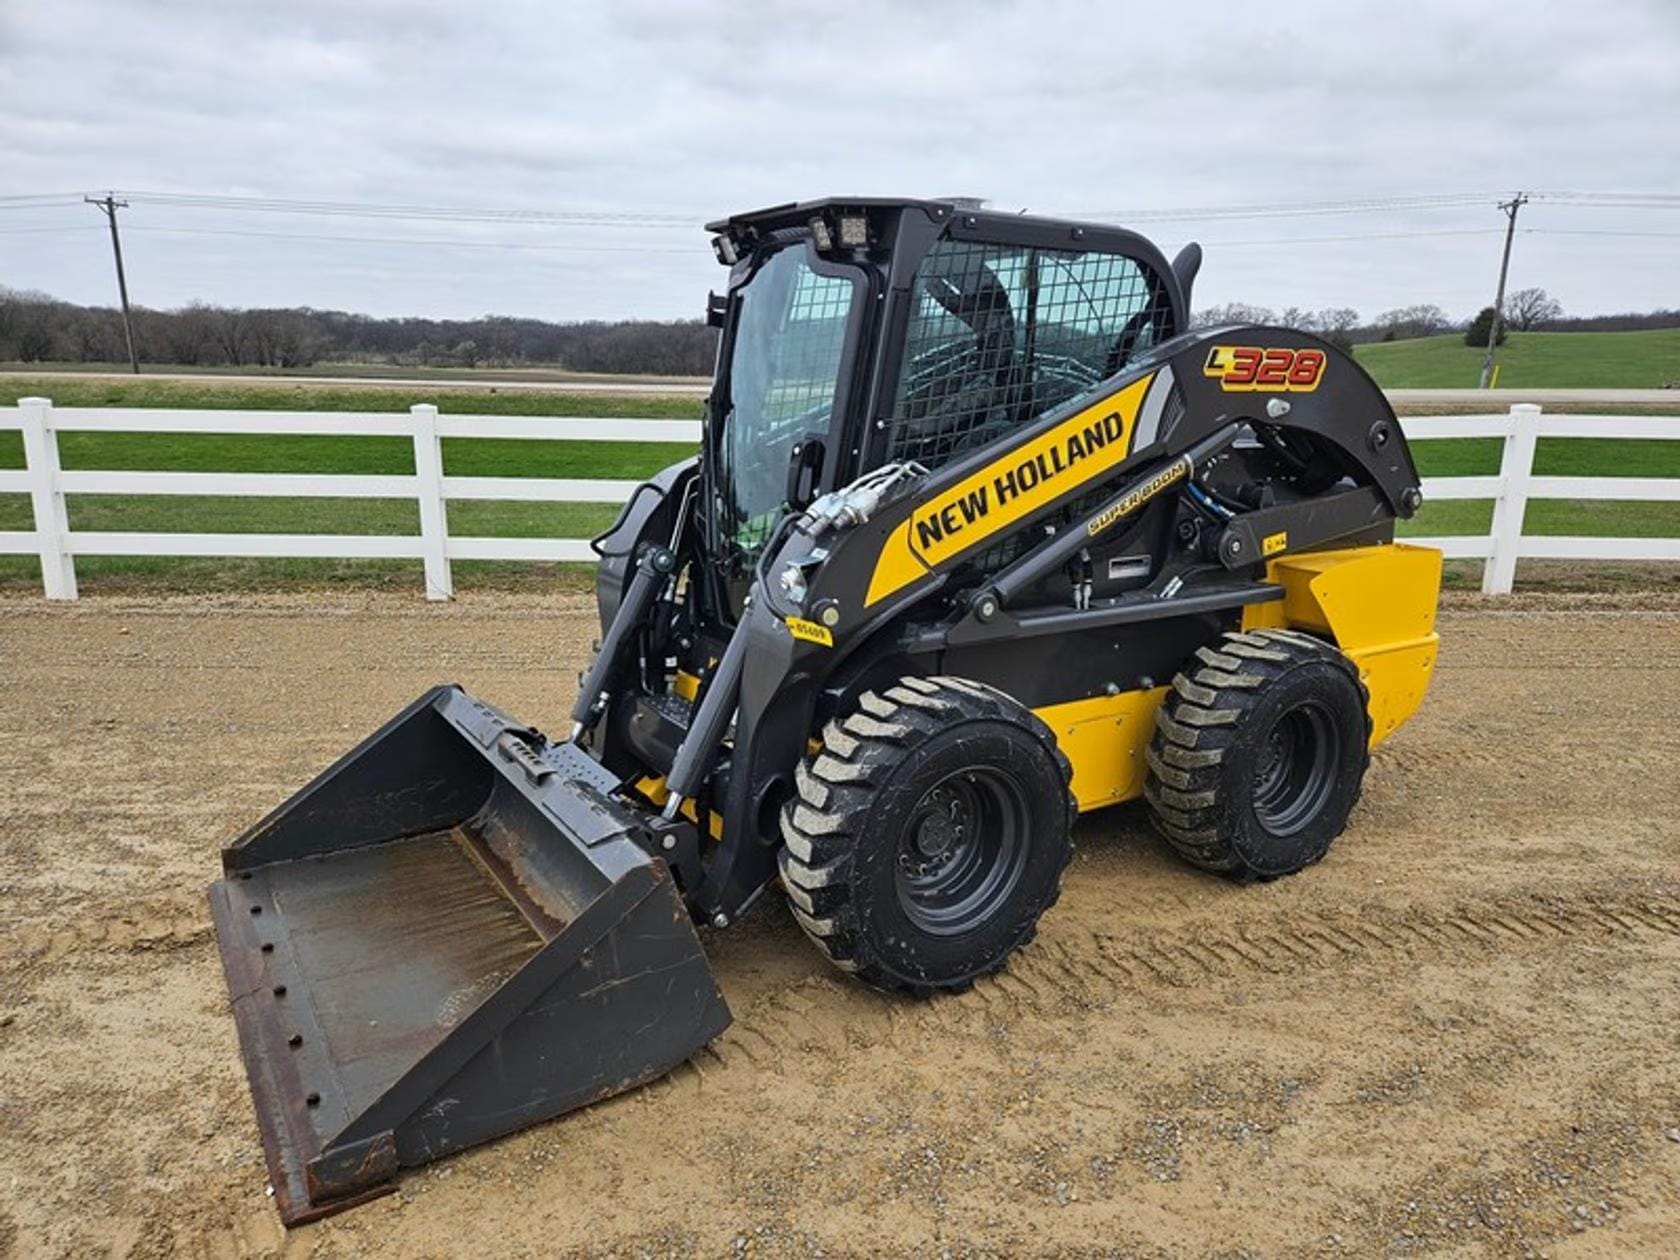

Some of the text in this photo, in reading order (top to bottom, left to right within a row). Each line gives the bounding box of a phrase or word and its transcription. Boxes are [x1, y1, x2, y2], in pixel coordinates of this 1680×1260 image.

[1204, 347, 1325, 389] L328
[916, 411, 1124, 549] NEW HOLLAND
